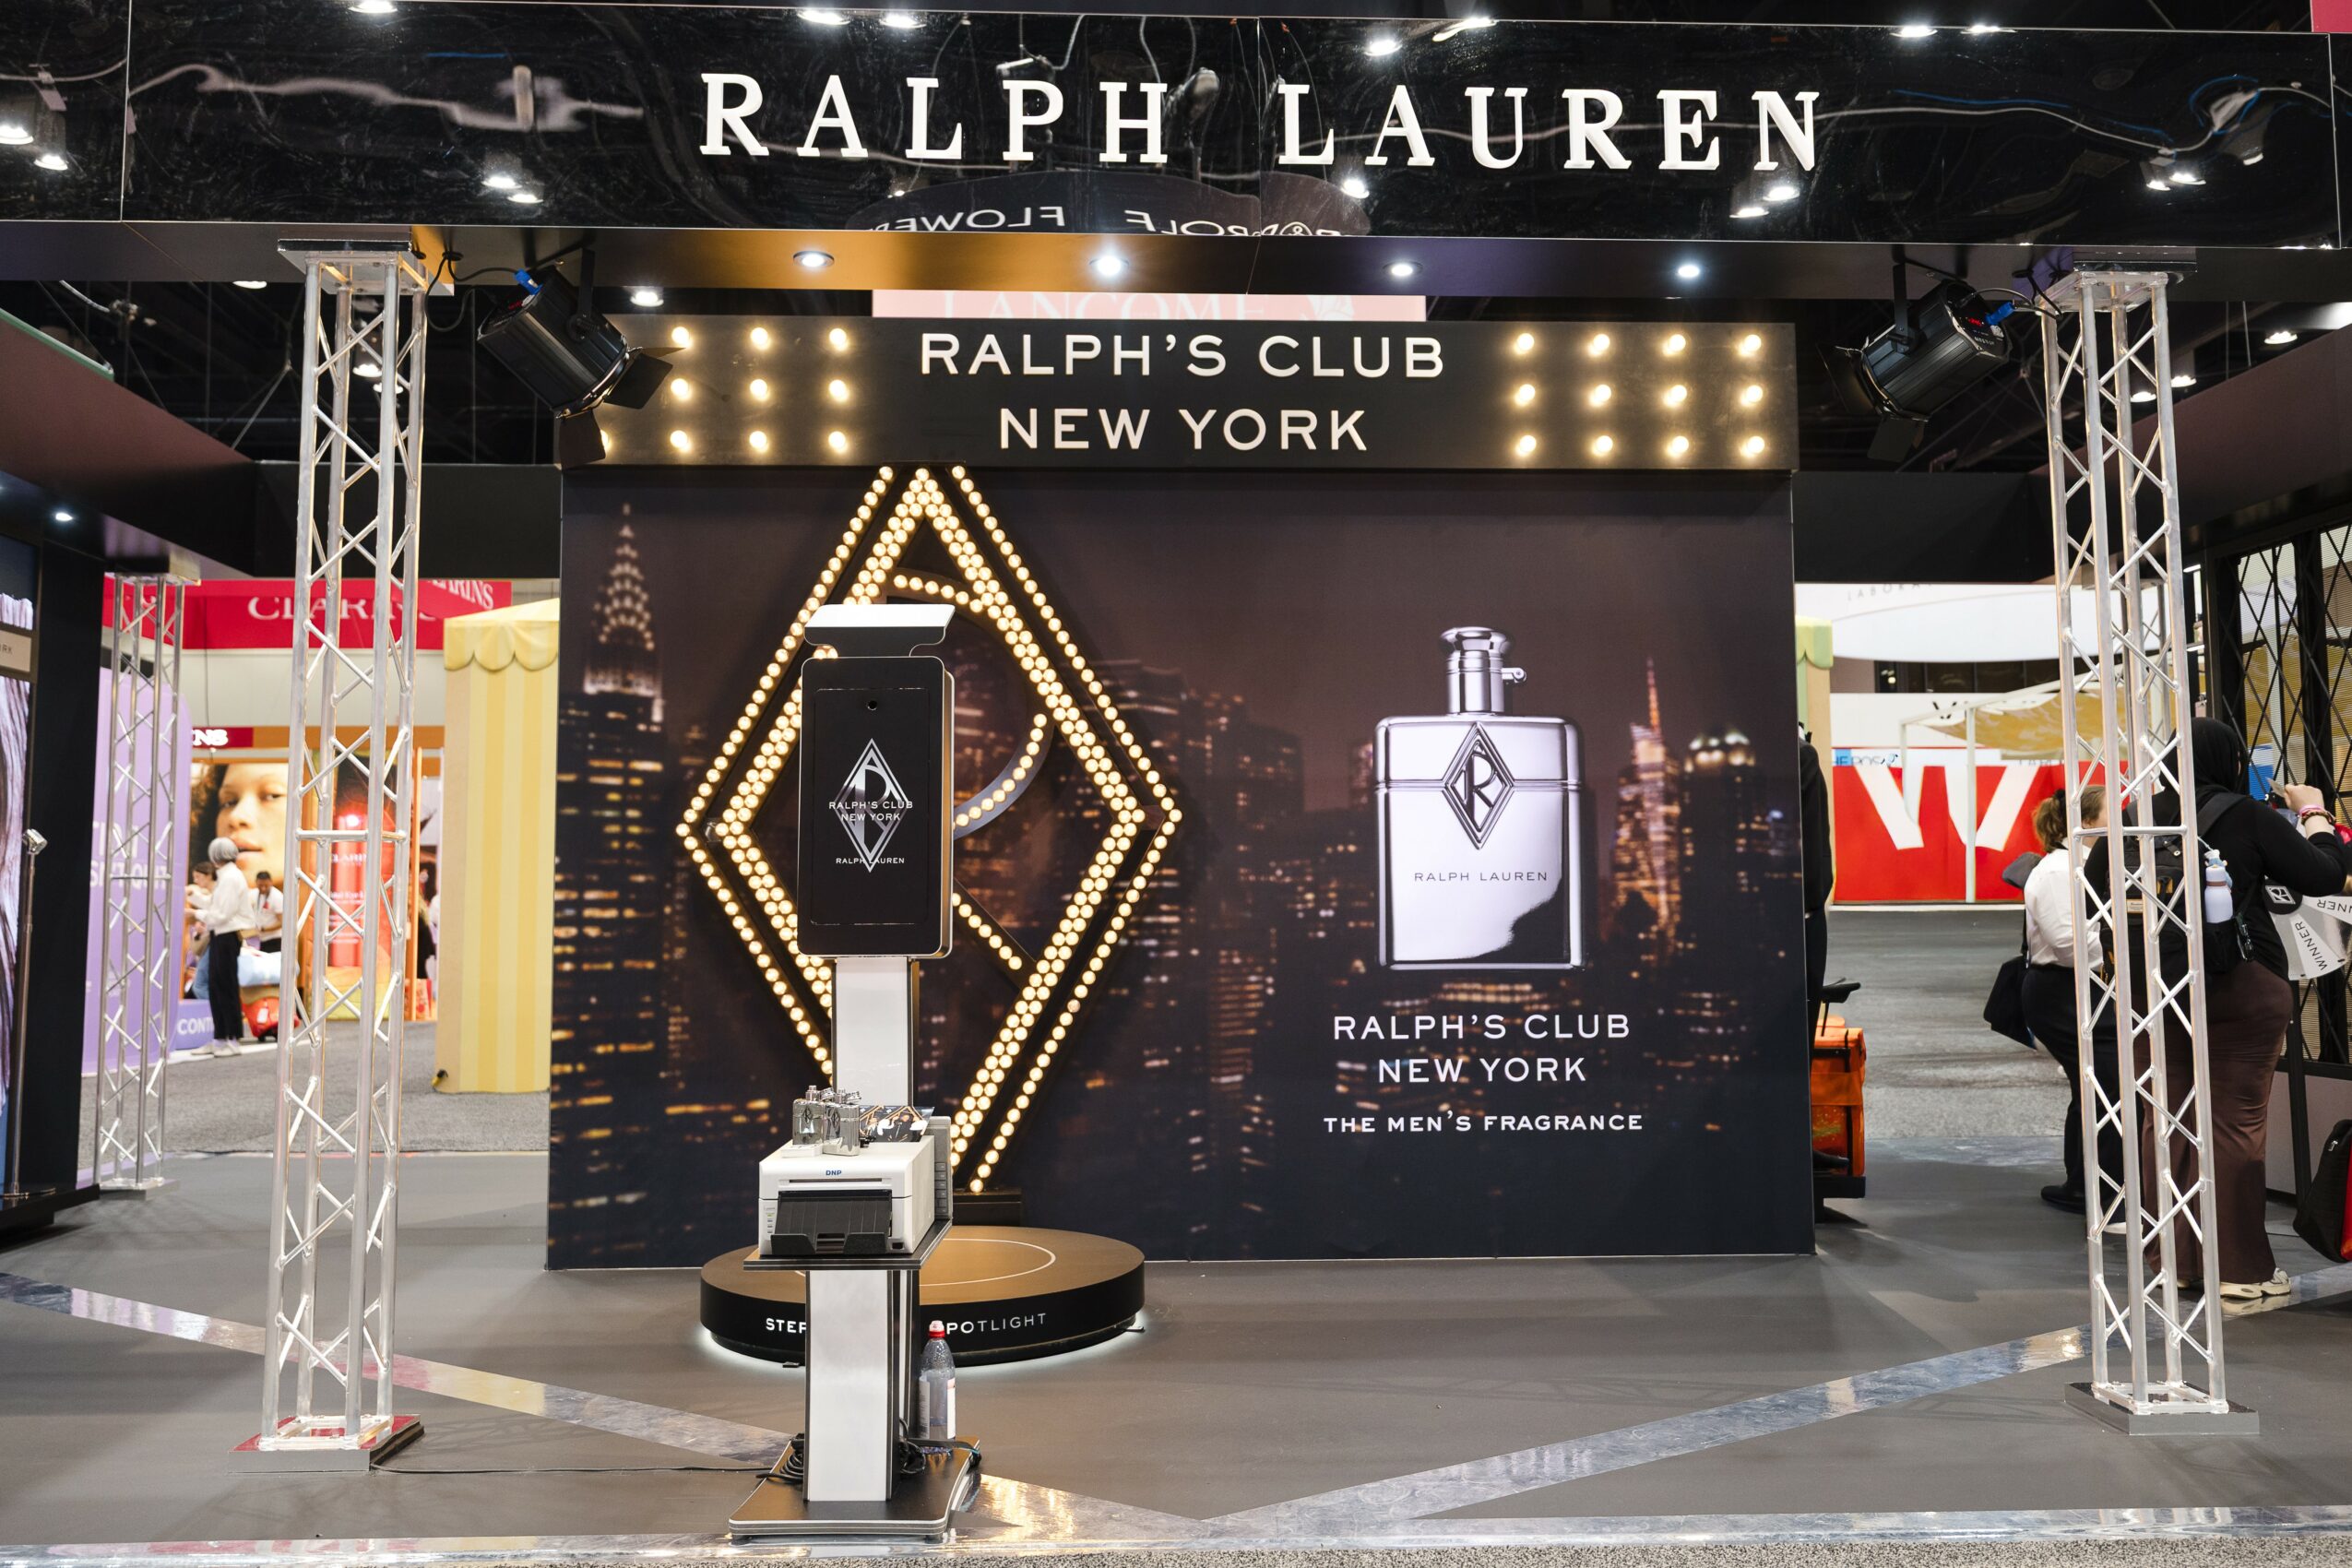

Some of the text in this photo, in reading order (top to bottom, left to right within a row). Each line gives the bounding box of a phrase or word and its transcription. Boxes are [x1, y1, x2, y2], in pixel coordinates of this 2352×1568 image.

[699, 73, 1821, 172] RALPH LAUREN
[921, 332, 1444, 378] RALPH'S CLUB
[999, 408, 1368, 451] NEW YORK
[828, 801, 913, 810] RALPH'S CLUB
[870, 813, 901, 821] YORK
[1414, 872, 1548, 882] RALPH LAUREN
[2295, 921, 2328, 971] WINNER
[1334, 1014, 1631, 1040] RALPH'S CLUB
[1378, 1057, 1586, 1083] NEW YORK
[1324, 1110, 1644, 1133] THE MEN'S FRAGRANCE
[945, 1313, 1047, 1335] POTLIGHT
